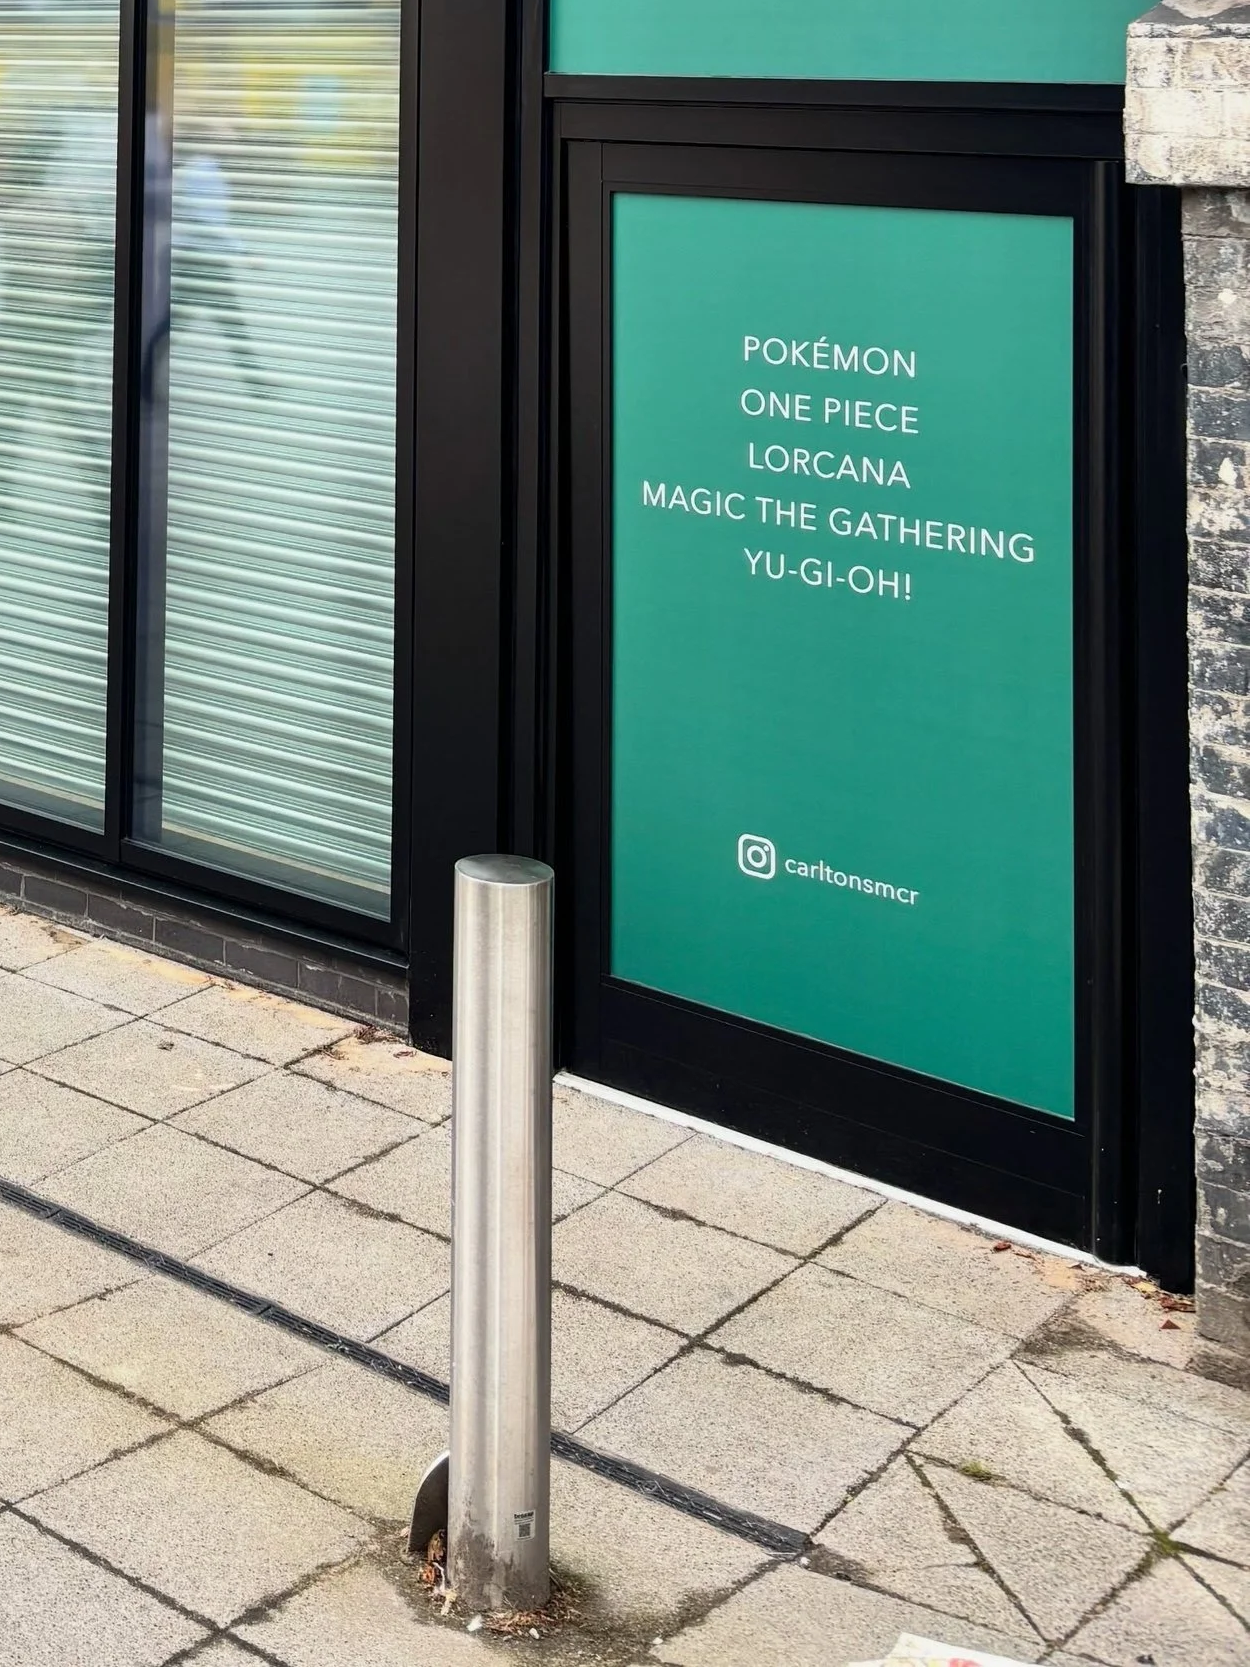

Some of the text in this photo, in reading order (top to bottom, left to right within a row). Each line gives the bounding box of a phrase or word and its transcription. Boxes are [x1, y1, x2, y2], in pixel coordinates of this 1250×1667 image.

[743, 335, 917, 379] POKÉMON
[740, 388, 920, 435] ONE PIECE
[748, 441, 912, 490] LORCANA
[642, 480, 1036, 564] MAGIC THE GATHERING
[743, 547, 913, 601] YU-GI-OH!
[784, 857, 920, 906] carltonsmcr
